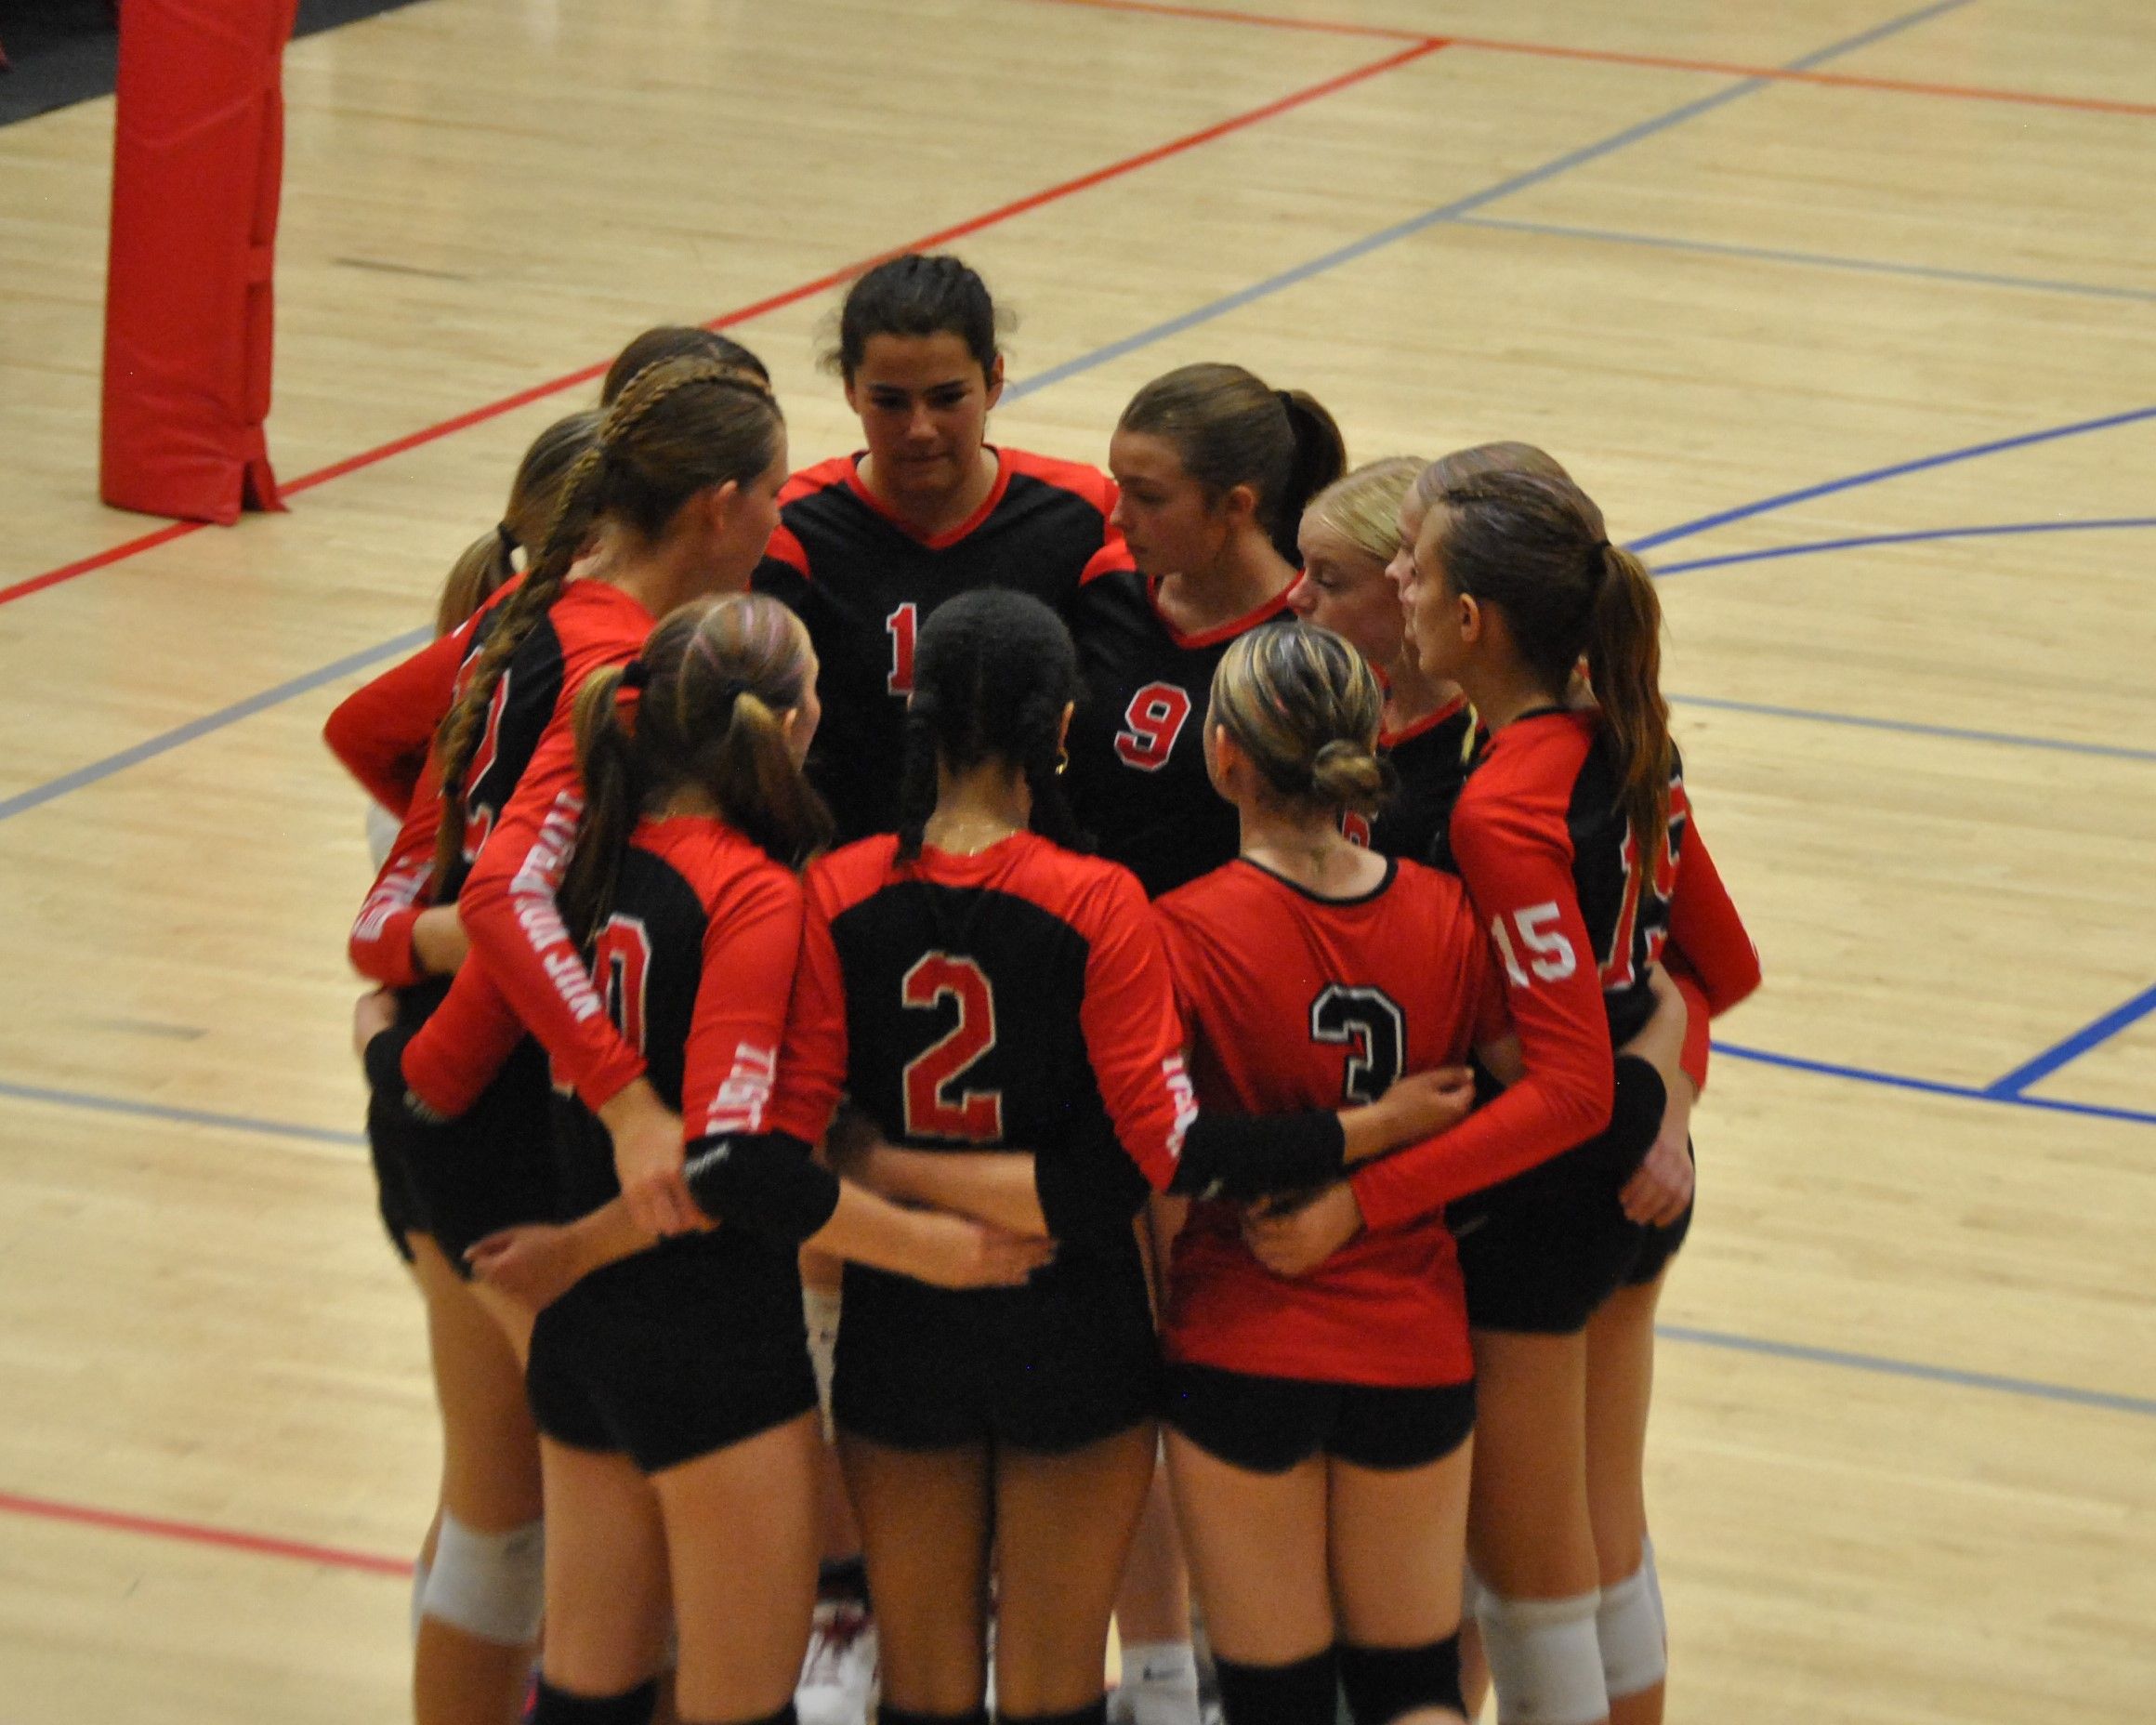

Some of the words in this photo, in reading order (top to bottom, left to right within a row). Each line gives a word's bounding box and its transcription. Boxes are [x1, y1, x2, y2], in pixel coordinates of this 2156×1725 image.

[1114, 681, 1191, 771] 9
[1492, 901, 1577, 988] 15
[901, 950, 1003, 1142] 2
[1309, 982, 1407, 1107] 3
